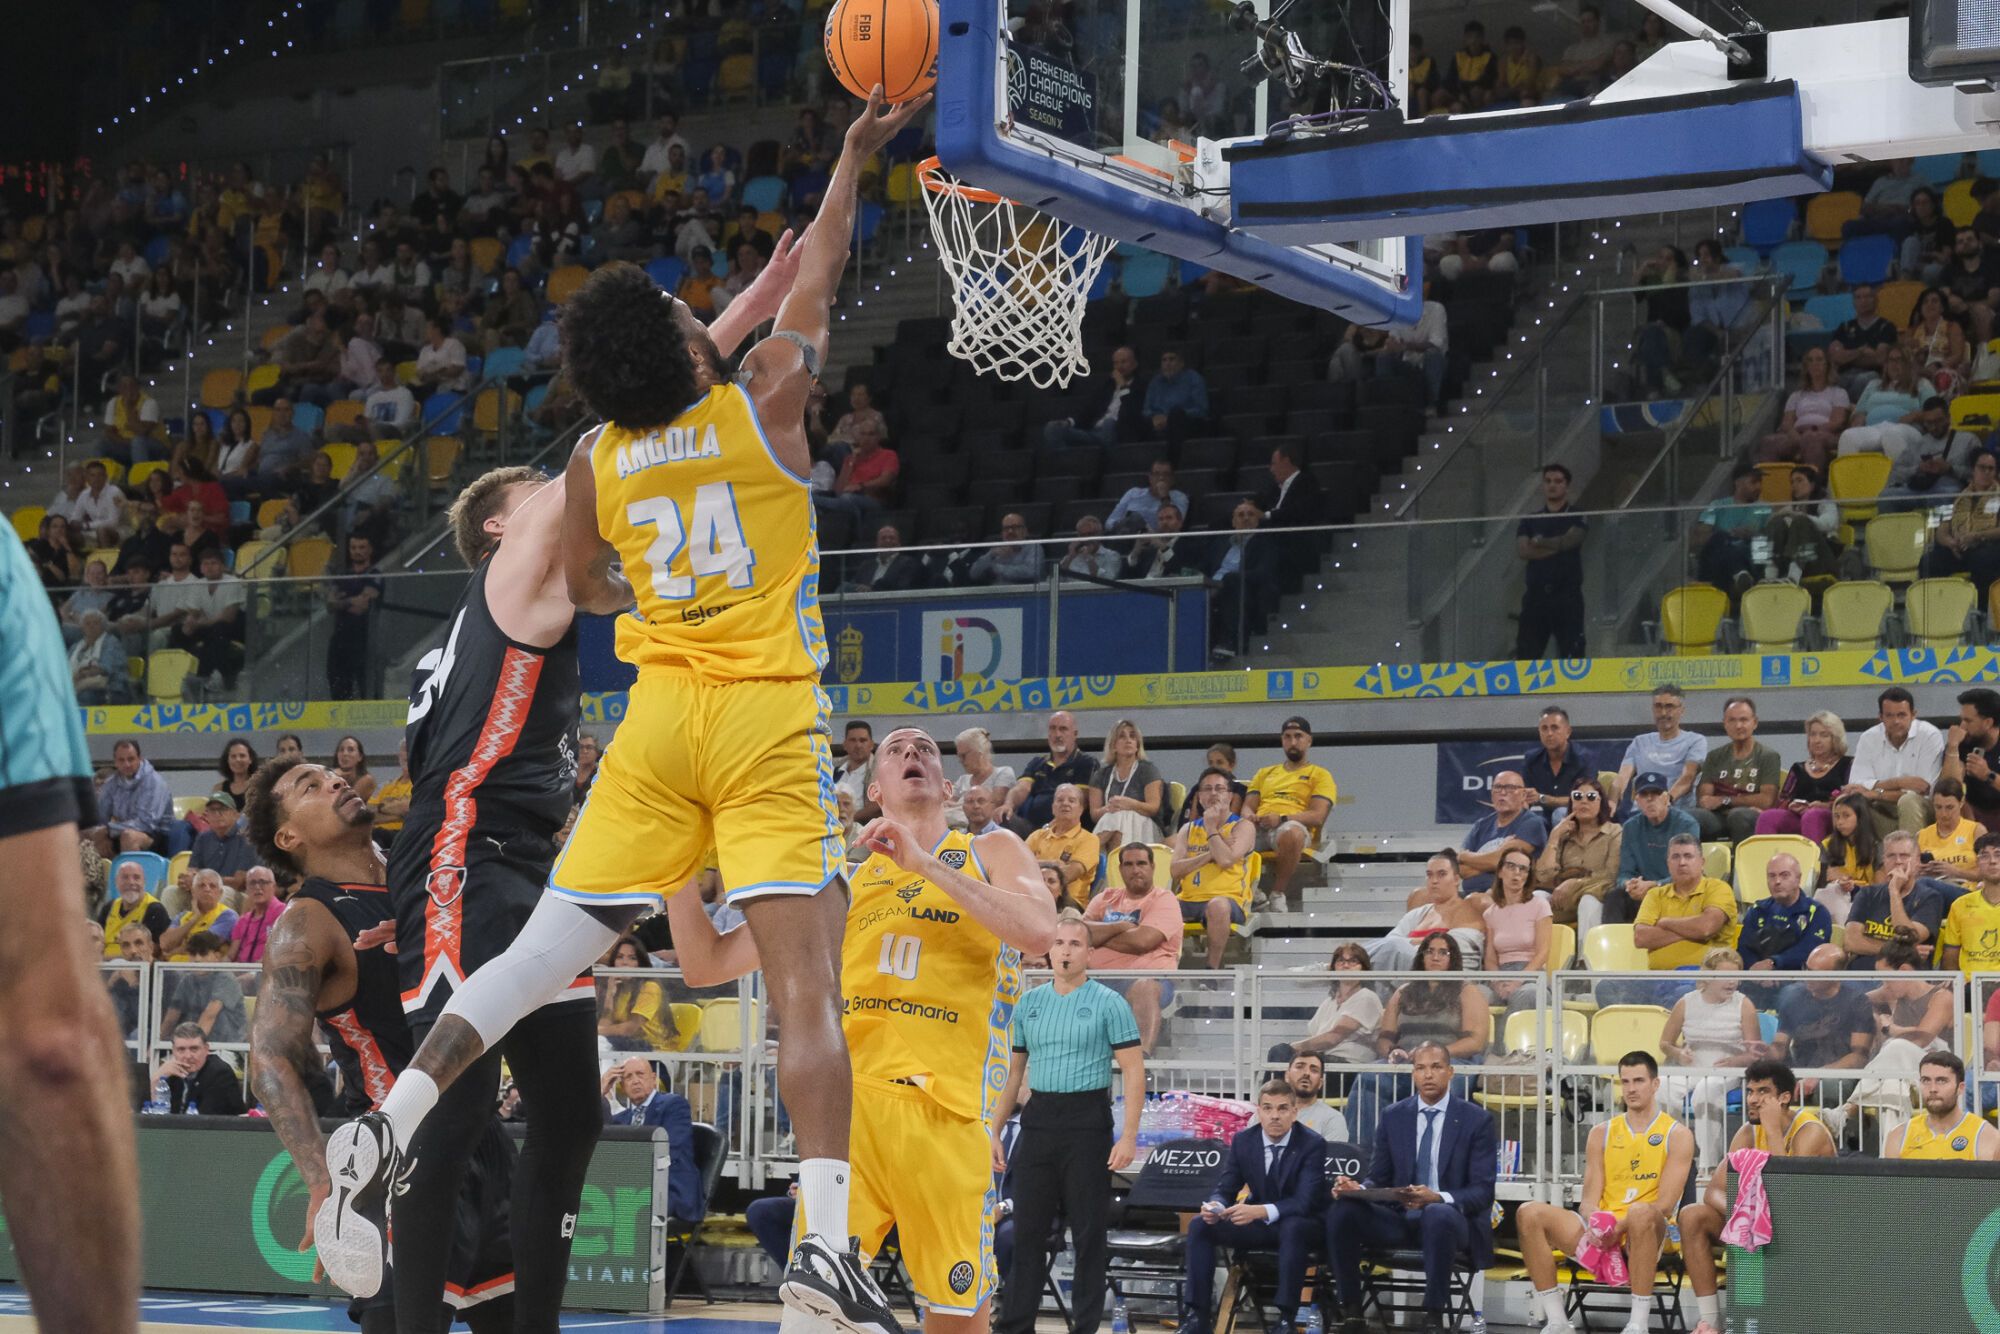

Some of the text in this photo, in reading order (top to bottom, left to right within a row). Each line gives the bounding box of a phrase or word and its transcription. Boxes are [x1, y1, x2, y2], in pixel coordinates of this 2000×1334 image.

[860, 14, 872, 41] FIBA
[1030, 57, 1086, 90] BASKETBALL
[1029, 72, 1092, 109] CHAMPIONS
[1029, 89, 1063, 113] LEAGUE
[1028, 108, 1057, 127] SEASON
[616, 423, 721, 480] ANGOLA
[626, 481, 757, 599] 24
[1463, 775, 1493, 791] DI
[858, 906, 960, 931] DREAMLAND
[877, 932, 922, 981] 10
[852, 995, 959, 1024] GranCanaria
[1148, 1149, 1221, 1168] MEZZO
[1324, 1156, 1361, 1177] ZZO
